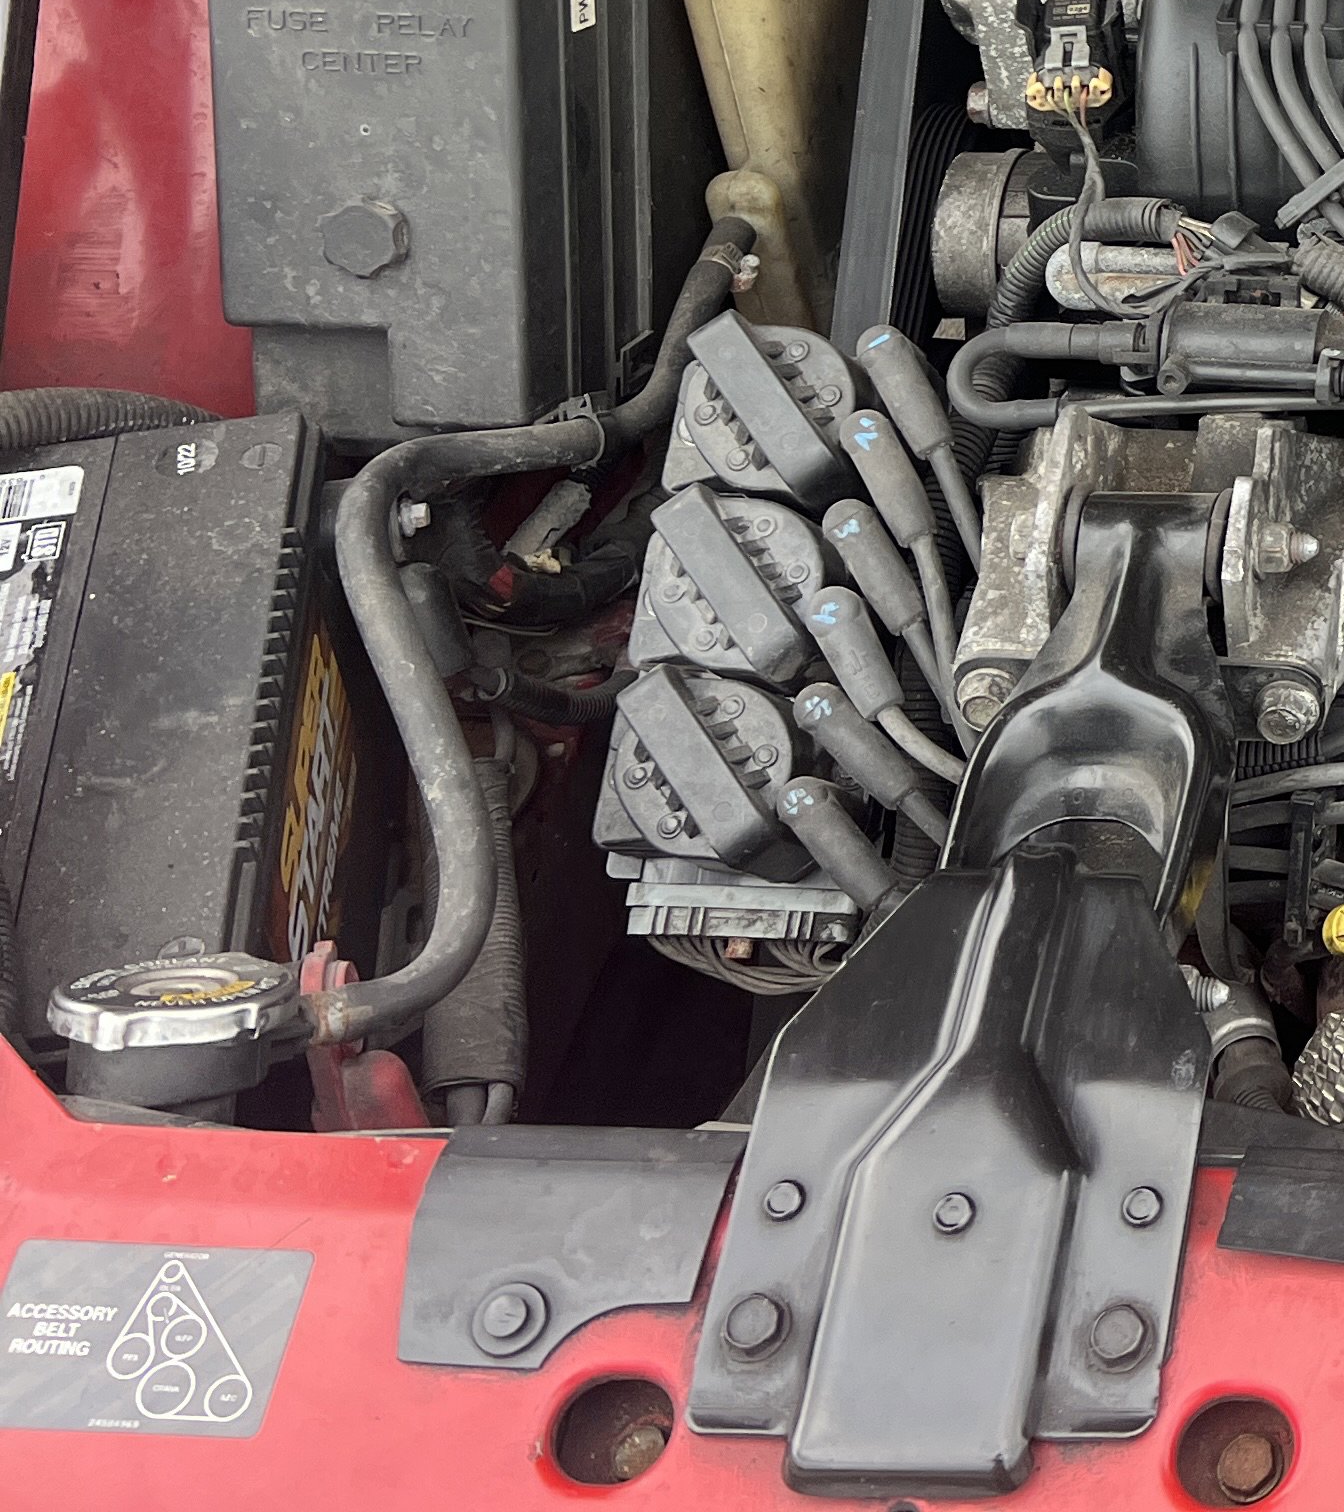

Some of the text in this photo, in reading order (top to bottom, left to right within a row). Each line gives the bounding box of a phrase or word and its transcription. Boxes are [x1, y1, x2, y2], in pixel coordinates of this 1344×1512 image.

[247, 8, 329, 33] FUSE
[301, 50, 423, 75] CENTER
[31, 527, 61, 557] STD
[288, 668, 337, 964] START
[7, 1303, 118, 1322] ACCESSORY
[33, 1322, 81, 1338] BELT
[8, 1339, 90, 1357] ROUTING
